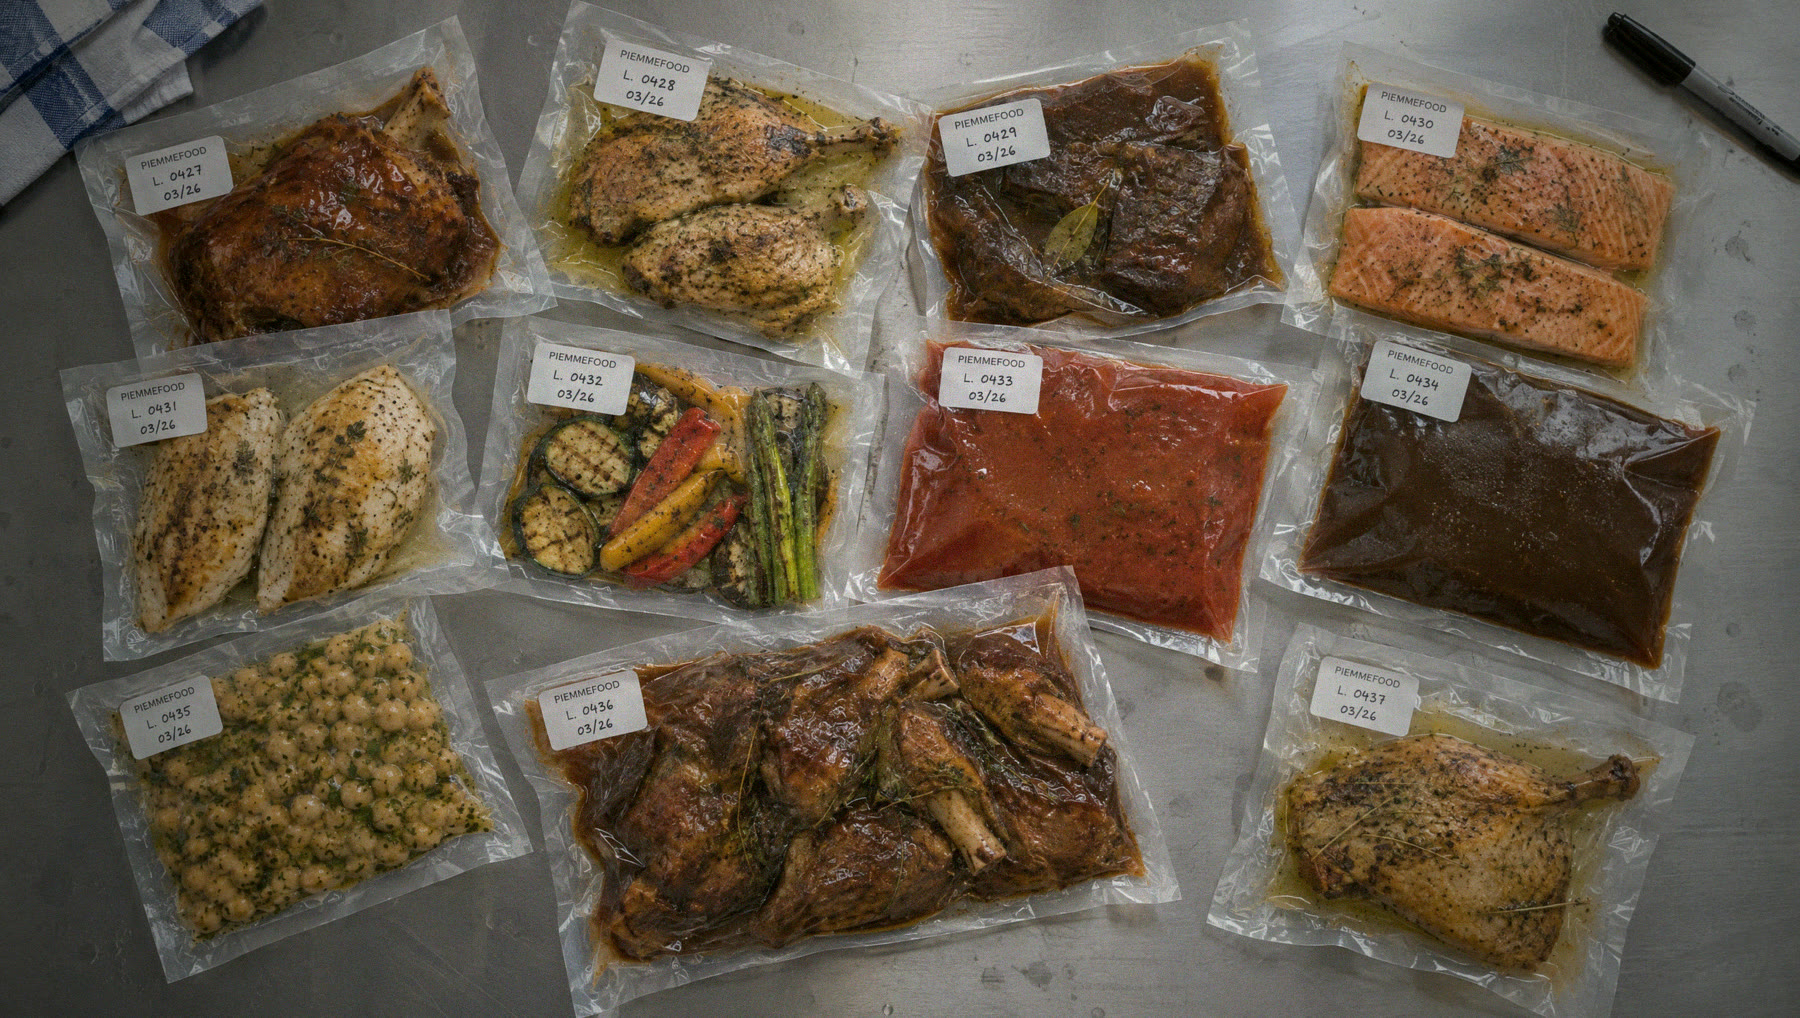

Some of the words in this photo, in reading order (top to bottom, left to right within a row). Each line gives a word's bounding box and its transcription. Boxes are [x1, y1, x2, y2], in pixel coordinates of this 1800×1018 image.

[619, 49, 690, 74] PIEMMEFOOD
[623, 69, 633, 81] L.
[641, 74, 676, 92] 0428
[625, 90, 664, 107] 03/26
[1380, 90, 1447, 113] PIEMMEFOOD
[954, 108, 1024, 130] PIEMMEFOOD
[1384, 110, 1394, 121] L.
[1401, 114, 1434, 129] 0430
[966, 137, 977, 148] L.
[983, 126, 1017, 143] 0429
[1387, 129, 1425, 145] 03/26
[140, 146, 207, 170] PIEMMEFOOD
[977, 145, 1016, 163] 03/26
[152, 176, 164, 187] L.
[169, 164, 202, 182] 0427
[163, 183, 201, 201] 03/26
[548, 351, 617, 369] PIEMMEFOOD
[957, 354, 1026, 368] PIEMMEFOOD
[1387, 349, 1454, 375] PIEMMEFOOD
[553, 369, 563, 381] L.
[570, 372, 603, 387] 0432
[963, 373, 974, 383] L.
[980, 374, 1013, 387] 0433
[1389, 368, 1399, 380] L.
[1406, 373, 1439, 392] 0434
[120, 382, 185, 401] PIEMMEFOOD
[557, 388, 595, 403] 03/26
[968, 389, 1007, 404] 03/26
[1391, 388, 1429, 406] 03/26
[131, 409, 142, 419] L.
[147, 401, 177, 416] 0431
[140, 419, 176, 435] 03/26
[1334, 665, 1401, 689] PIEMMEFOOD
[133, 686, 195, 714] PIEMMEFOOD
[553, 680, 620, 704] PIEMMEFOOD
[1337, 685, 1347, 696] L.
[1353, 689, 1386, 705] 0437
[146, 719, 157, 730] L.
[161, 704, 191, 724] 0435
[565, 710, 577, 721] L.
[582, 699, 614, 716] 0436
[1340, 705, 1377, 722] 03/26
[157, 724, 192, 744] 03/26
[577, 718, 613, 736] 03/26
